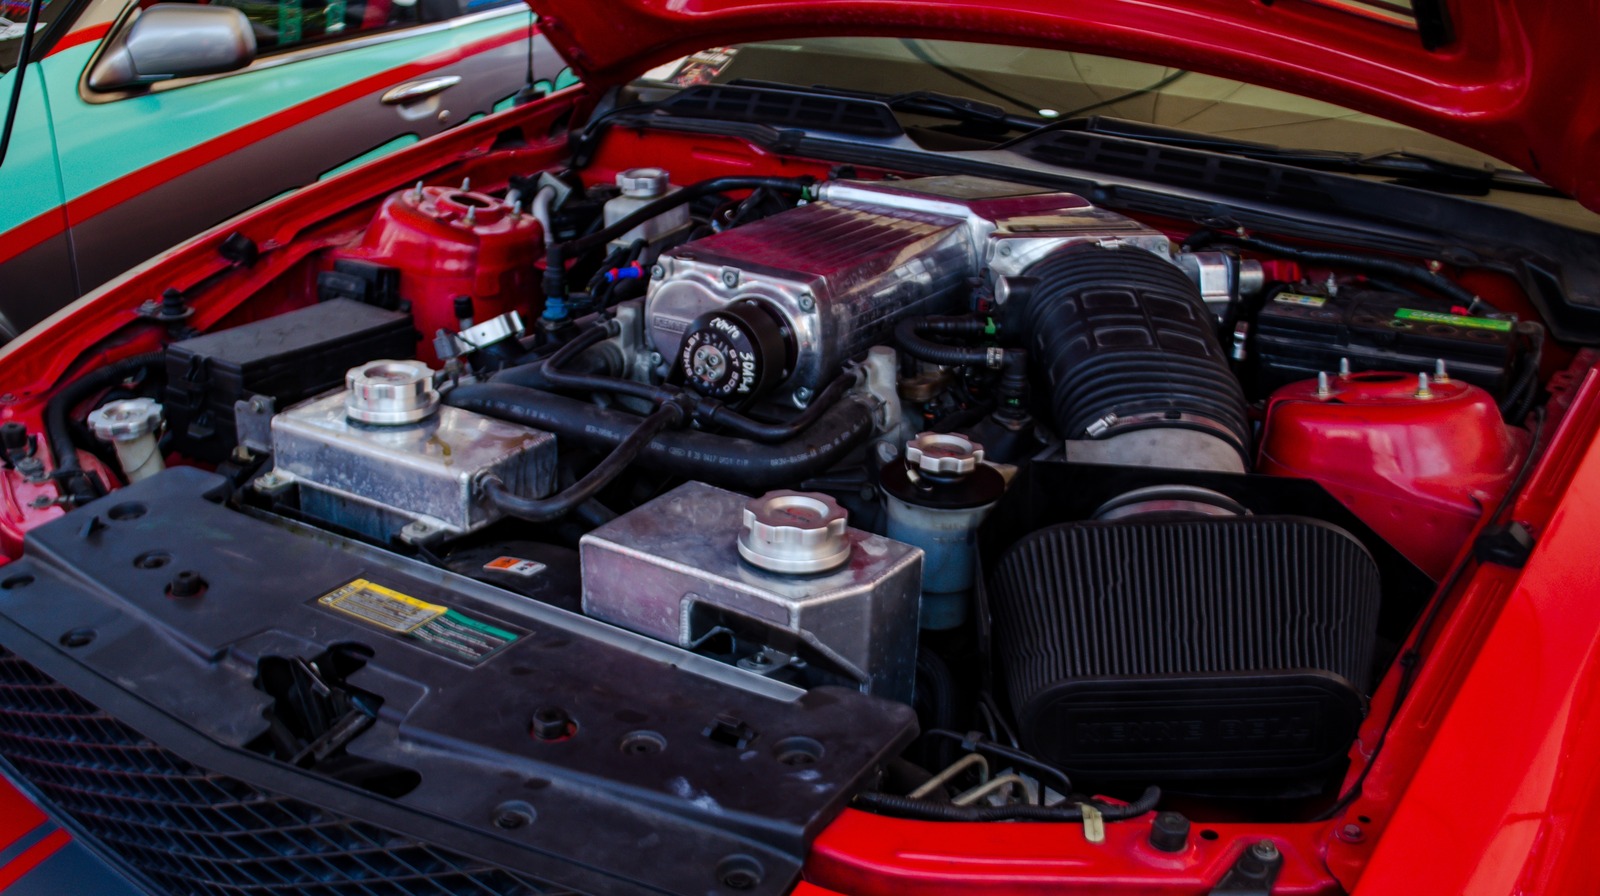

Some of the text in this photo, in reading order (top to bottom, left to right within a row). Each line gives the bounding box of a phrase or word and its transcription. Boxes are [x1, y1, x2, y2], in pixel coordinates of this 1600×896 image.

[683, 332, 700, 377] SHELBY
[729, 348, 740, 367] GT
[723, 371, 739, 393] 500
